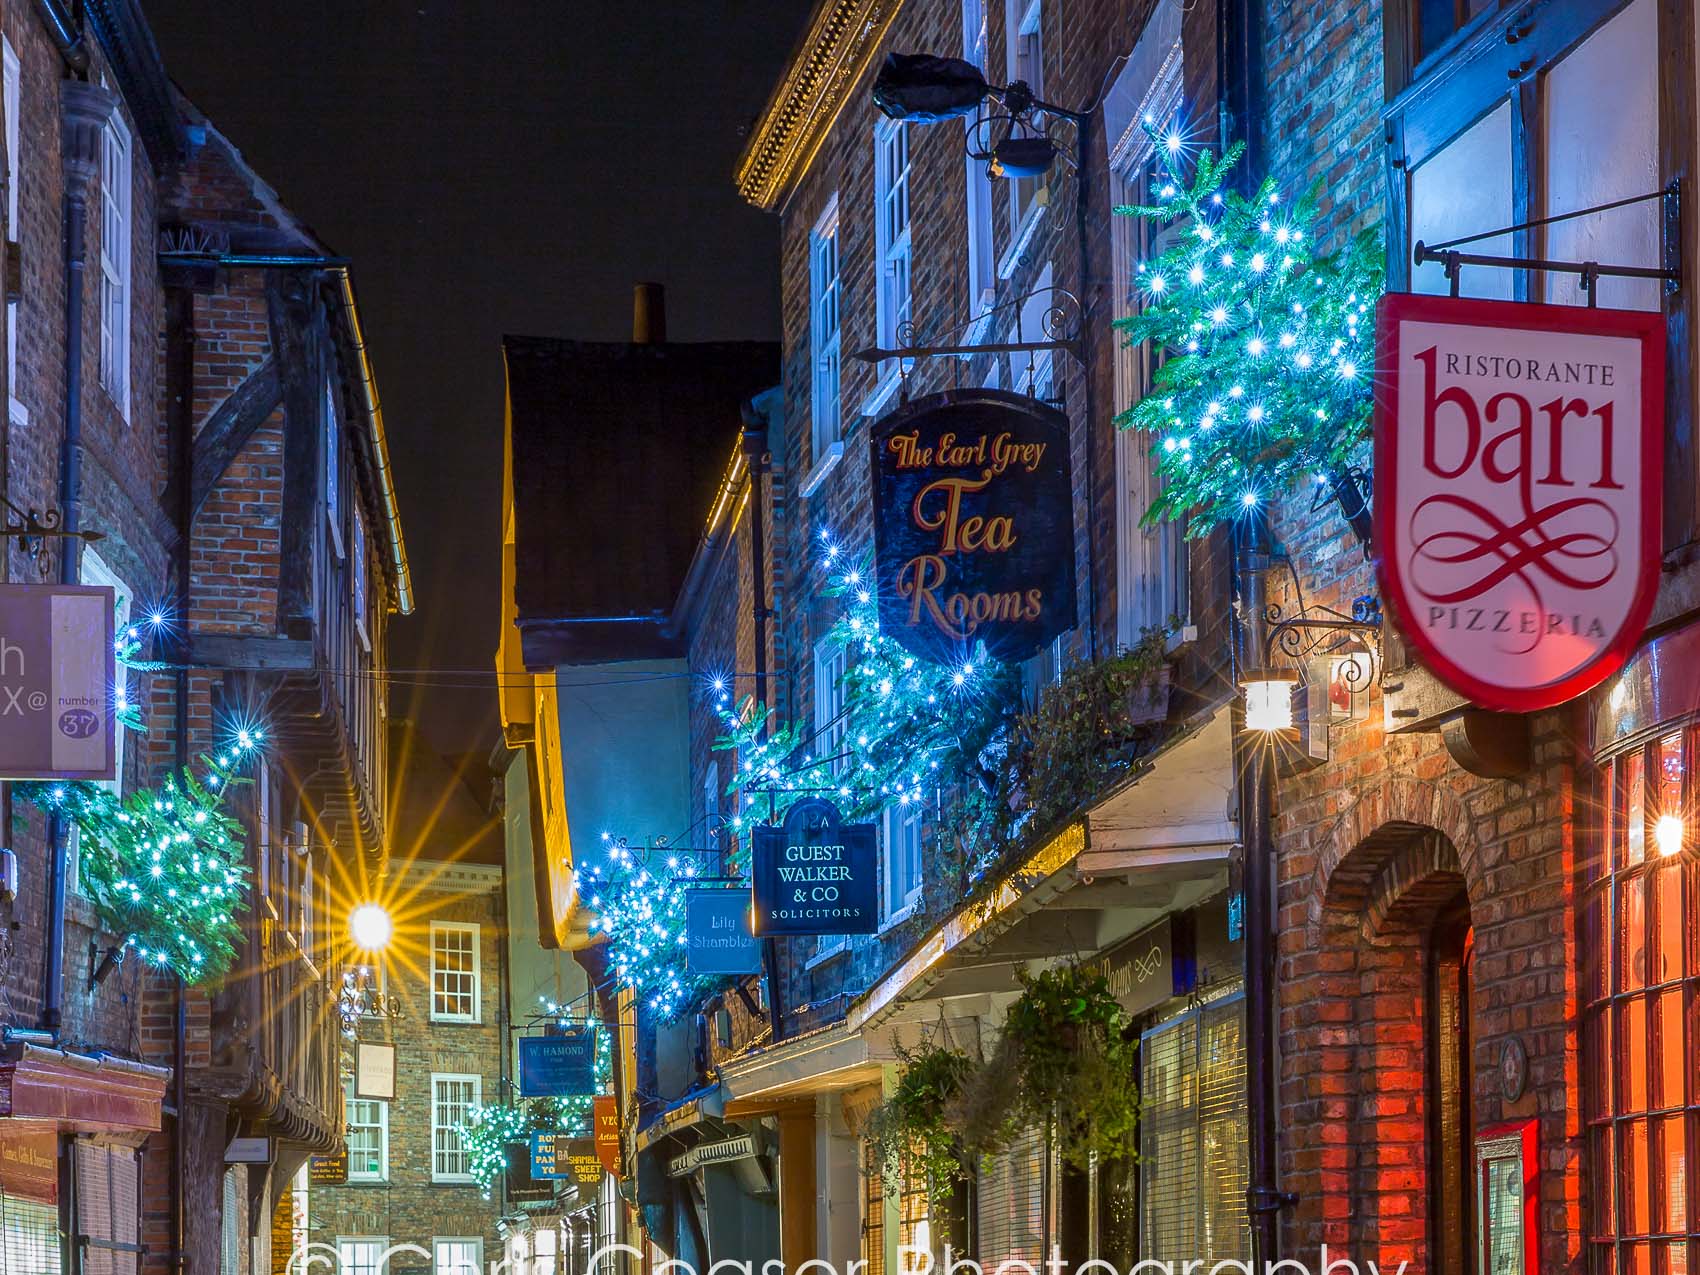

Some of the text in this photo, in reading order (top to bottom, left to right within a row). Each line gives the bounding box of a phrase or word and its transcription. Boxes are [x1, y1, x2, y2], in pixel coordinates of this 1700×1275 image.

[1446, 353, 1615, 386] RISTORANTE
[1413, 344, 1625, 498] bari
[888, 429, 1047, 473] The Earl Grey
[912, 469, 1017, 557] Tea
[895, 555, 1043, 641] Rooms
[1428, 606, 1606, 638] PIZZERIA
[58, 696, 99, 706] number
[63, 715, 95, 735] 37
[785, 845, 845, 862] GUEST
[777, 866, 854, 883] WALKER
[793, 886, 839, 903] & CO
[771, 908, 861, 920] SOLICITORS
[711, 915, 736, 931] Lily
[543, 1046, 584, 1057] HAMOND
[574, 1165, 602, 1174] SWEET
[578, 1174, 601, 1183] SHOP
